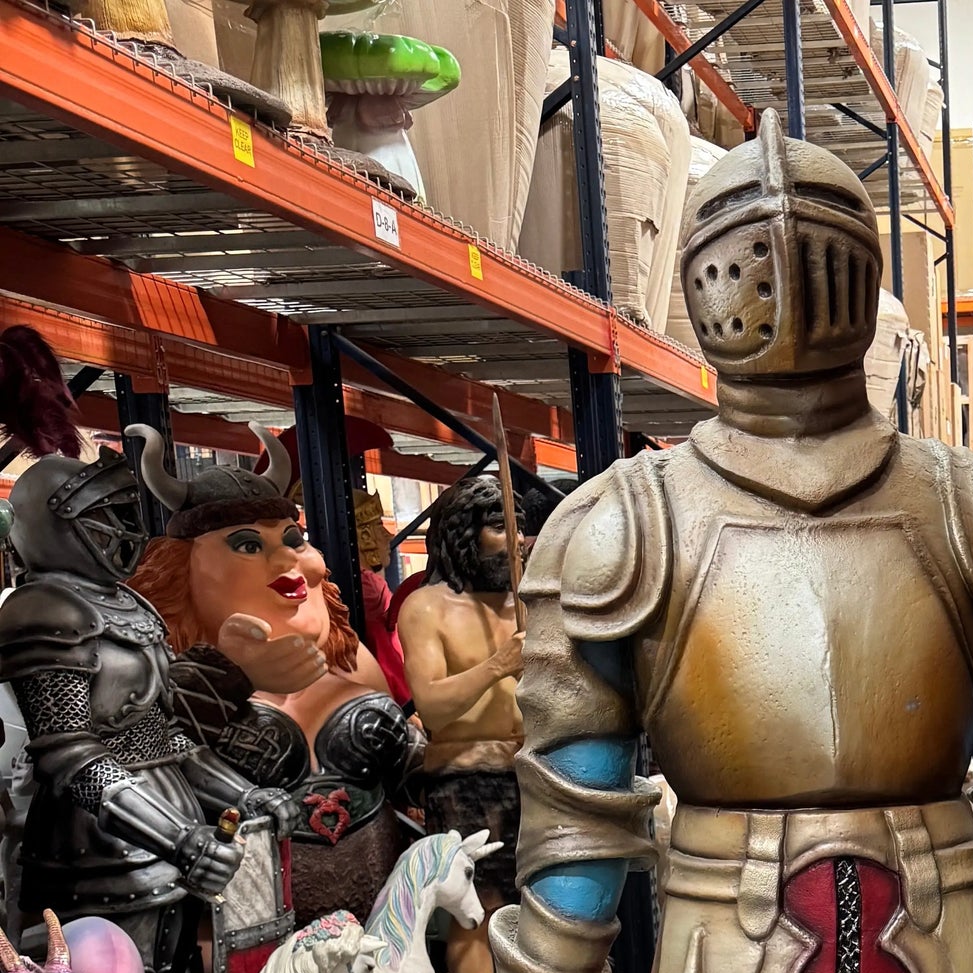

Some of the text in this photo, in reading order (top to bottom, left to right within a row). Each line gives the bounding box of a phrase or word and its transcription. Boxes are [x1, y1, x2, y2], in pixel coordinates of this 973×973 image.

[235, 128, 249, 141] KEEP
[235, 138, 251, 154] CLEAR
[375, 211, 398, 236] D-8-A
